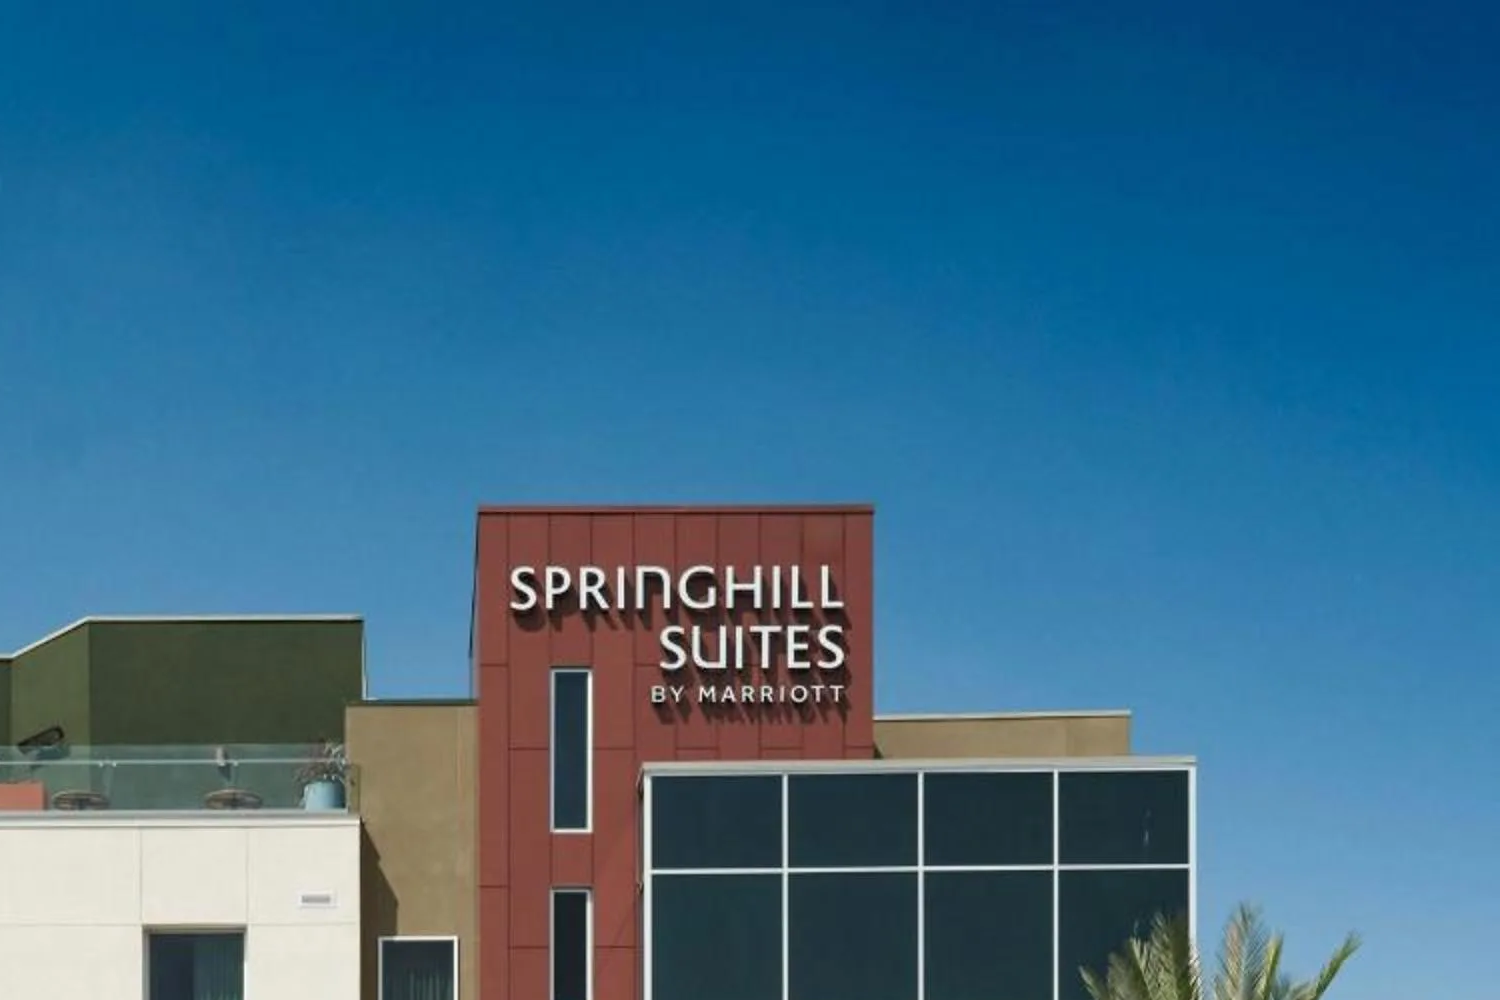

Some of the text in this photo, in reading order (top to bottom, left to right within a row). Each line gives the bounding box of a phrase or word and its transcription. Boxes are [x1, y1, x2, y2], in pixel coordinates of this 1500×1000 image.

[509, 564, 845, 610] SPRINGHILL
[659, 624, 845, 670] SUITES
[651, 684, 845, 704] BY MARRIOTT
